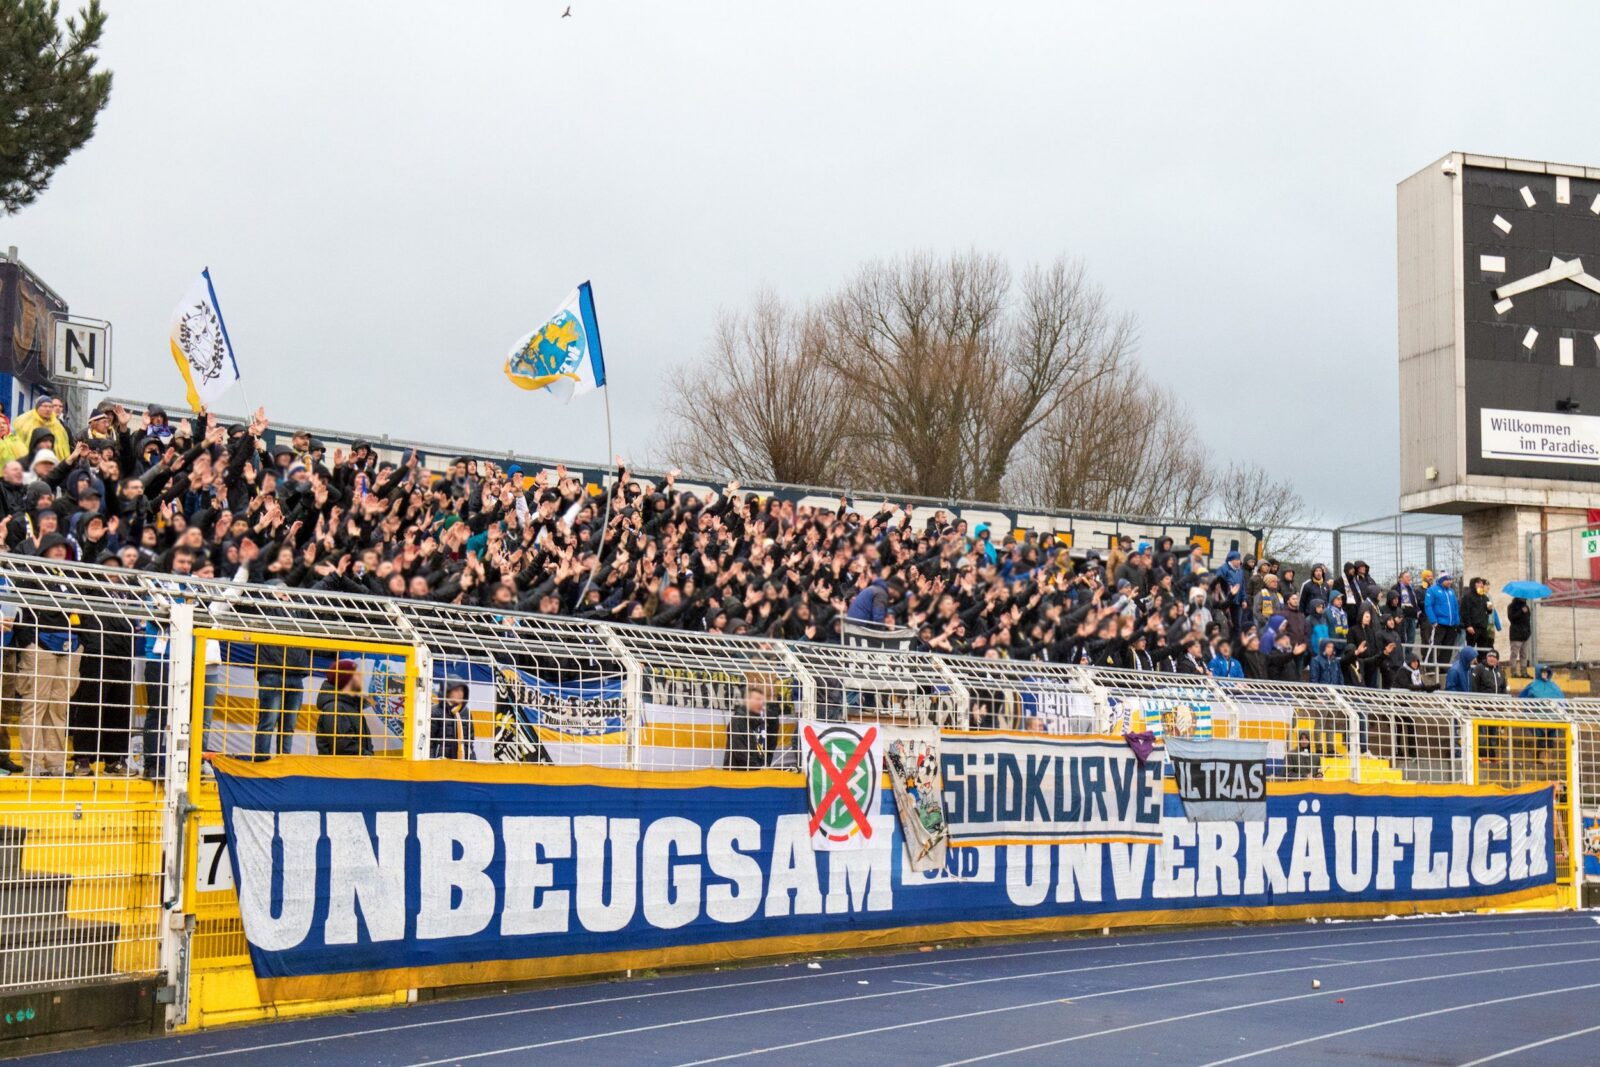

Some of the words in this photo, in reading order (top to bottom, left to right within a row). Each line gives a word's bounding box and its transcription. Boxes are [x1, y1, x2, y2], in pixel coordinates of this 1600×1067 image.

[65, 328, 96, 377] N
[1491, 417, 1571, 436] Willkommen
[1520, 437, 1536, 450] im
[1541, 438, 1599, 454] Paradies.
[940, 753, 1162, 824] SÜDKURVE
[203, 833, 228, 885] 7
[232, 806, 895, 951] UNBEUGSAM
[1005, 799, 1549, 907] UNVERKÄUFLICH
